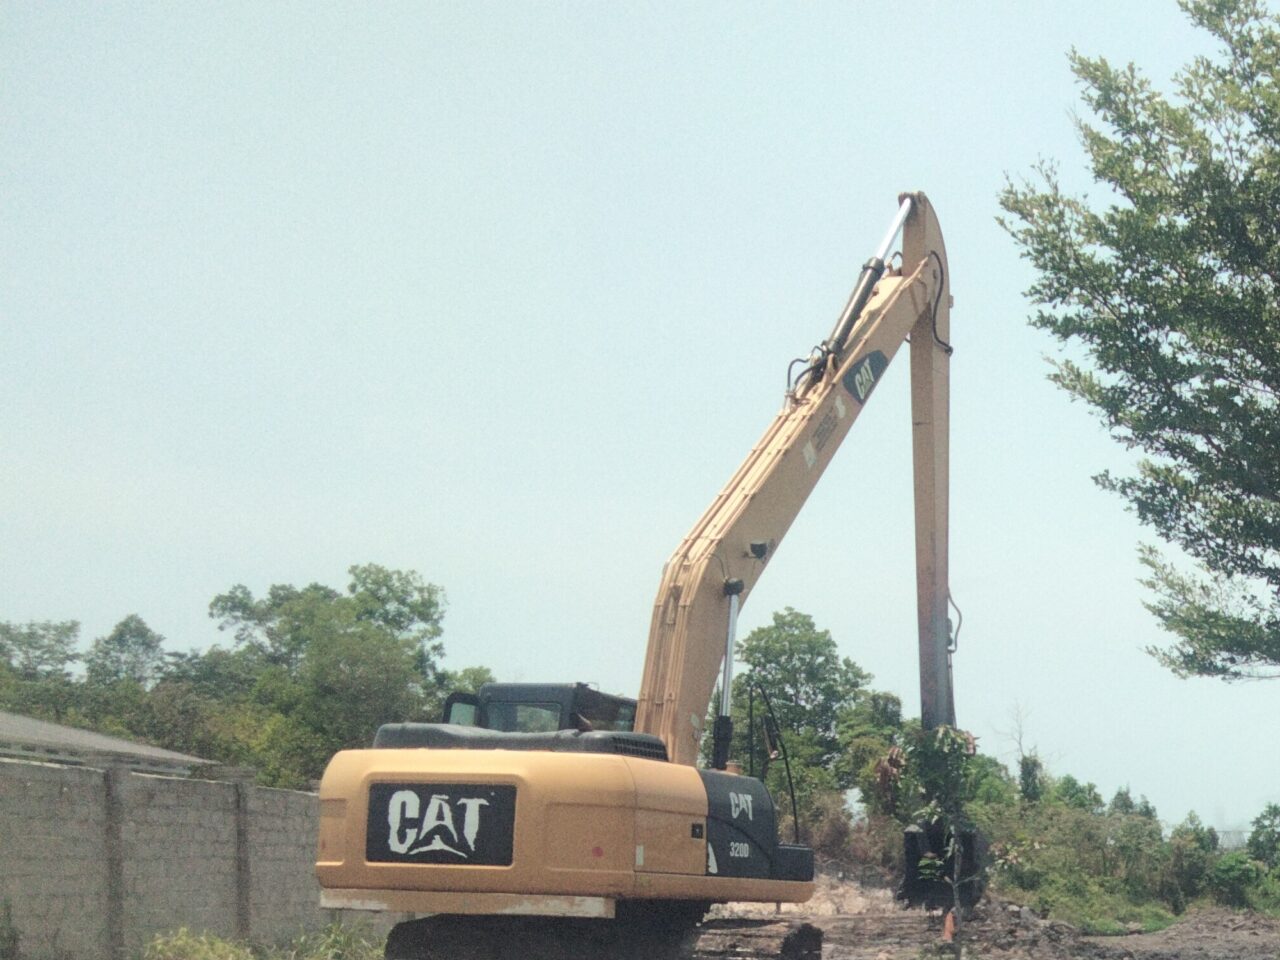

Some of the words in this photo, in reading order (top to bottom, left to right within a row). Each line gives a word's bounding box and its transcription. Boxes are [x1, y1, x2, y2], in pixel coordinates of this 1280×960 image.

[855, 358, 875, 400] CAT
[387, 789, 490, 858] CAT
[729, 791, 753, 821] CAT
[730, 842, 749, 857] 320D
